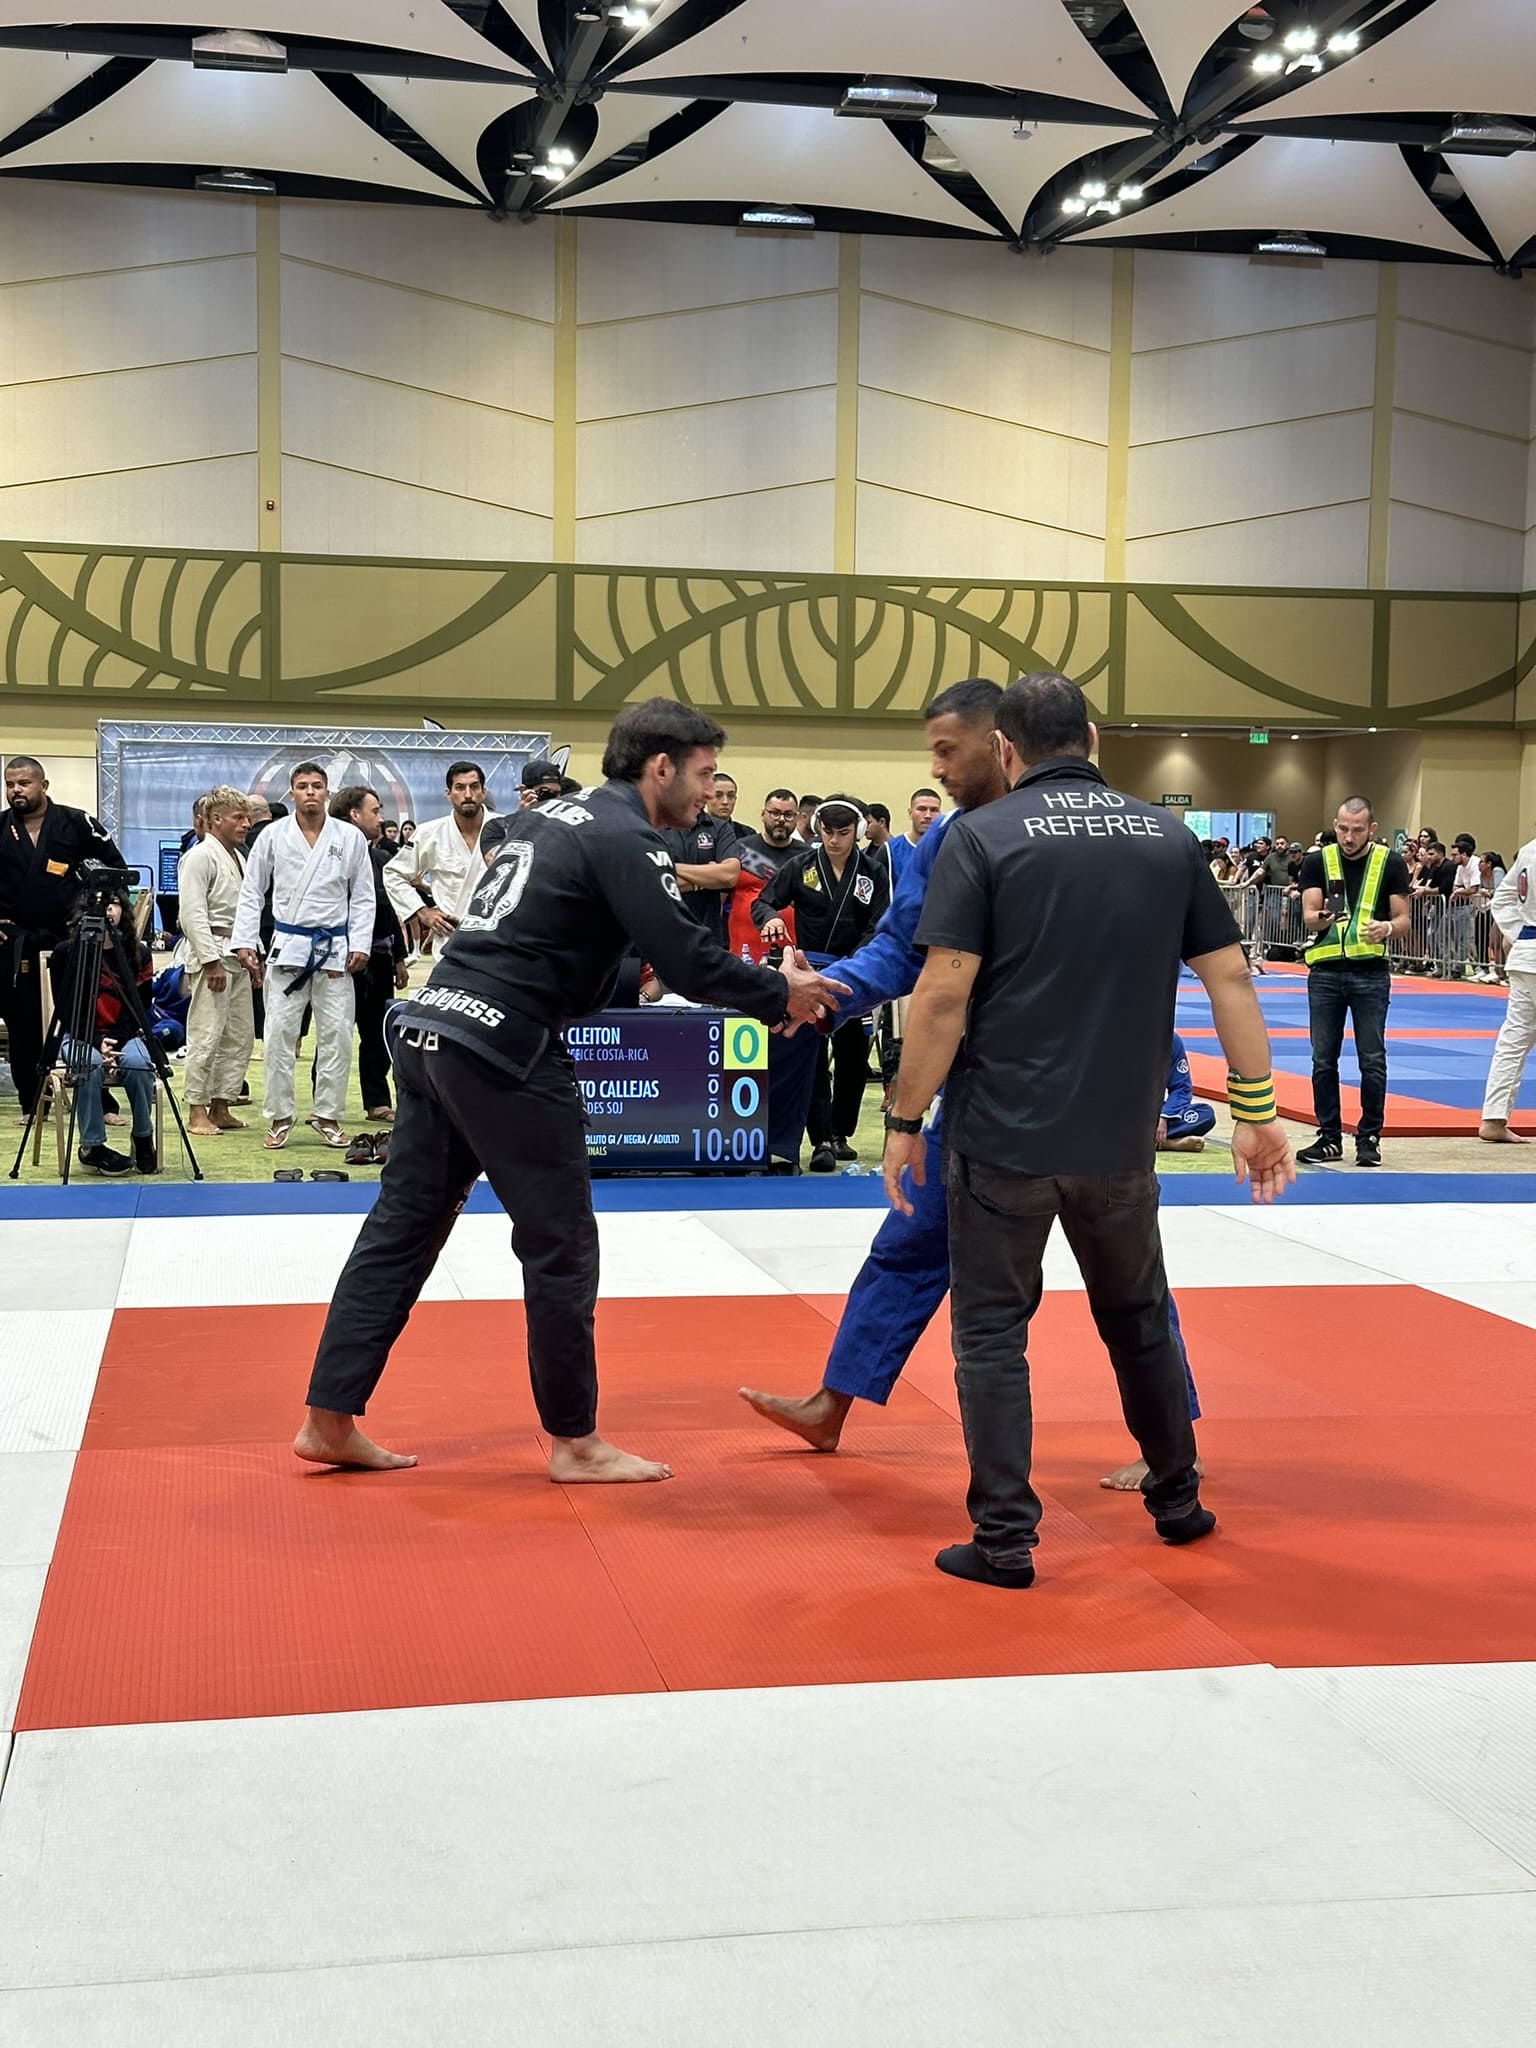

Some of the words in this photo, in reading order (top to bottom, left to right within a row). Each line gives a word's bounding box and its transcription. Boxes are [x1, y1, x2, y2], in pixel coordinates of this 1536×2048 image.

[1042, 792, 1125, 809] HEAD
[1164, 796, 1190, 805] SALIDA
[1023, 814, 1164, 837] REFEREE
[567, 1027, 621, 1045] CLEITON
[708, 1025, 720, 1041] 0
[733, 1024, 760, 1064] 0
[596, 1048, 649, 1061] COSTA-RICA
[708, 1049, 719, 1066] 0
[599, 1080, 660, 1098] CALLEJAS
[708, 1078, 719, 1094] 0
[731, 1076, 760, 1118] 0
[607, 1101, 623, 1114] SOJ
[708, 1102, 719, 1119] 0
[608, 1134, 616, 1145] GI
[623, 1134, 646, 1145] NEGRA
[653, 1134, 680, 1145] ADULTO
[692, 1128, 765, 1162] 10:00
